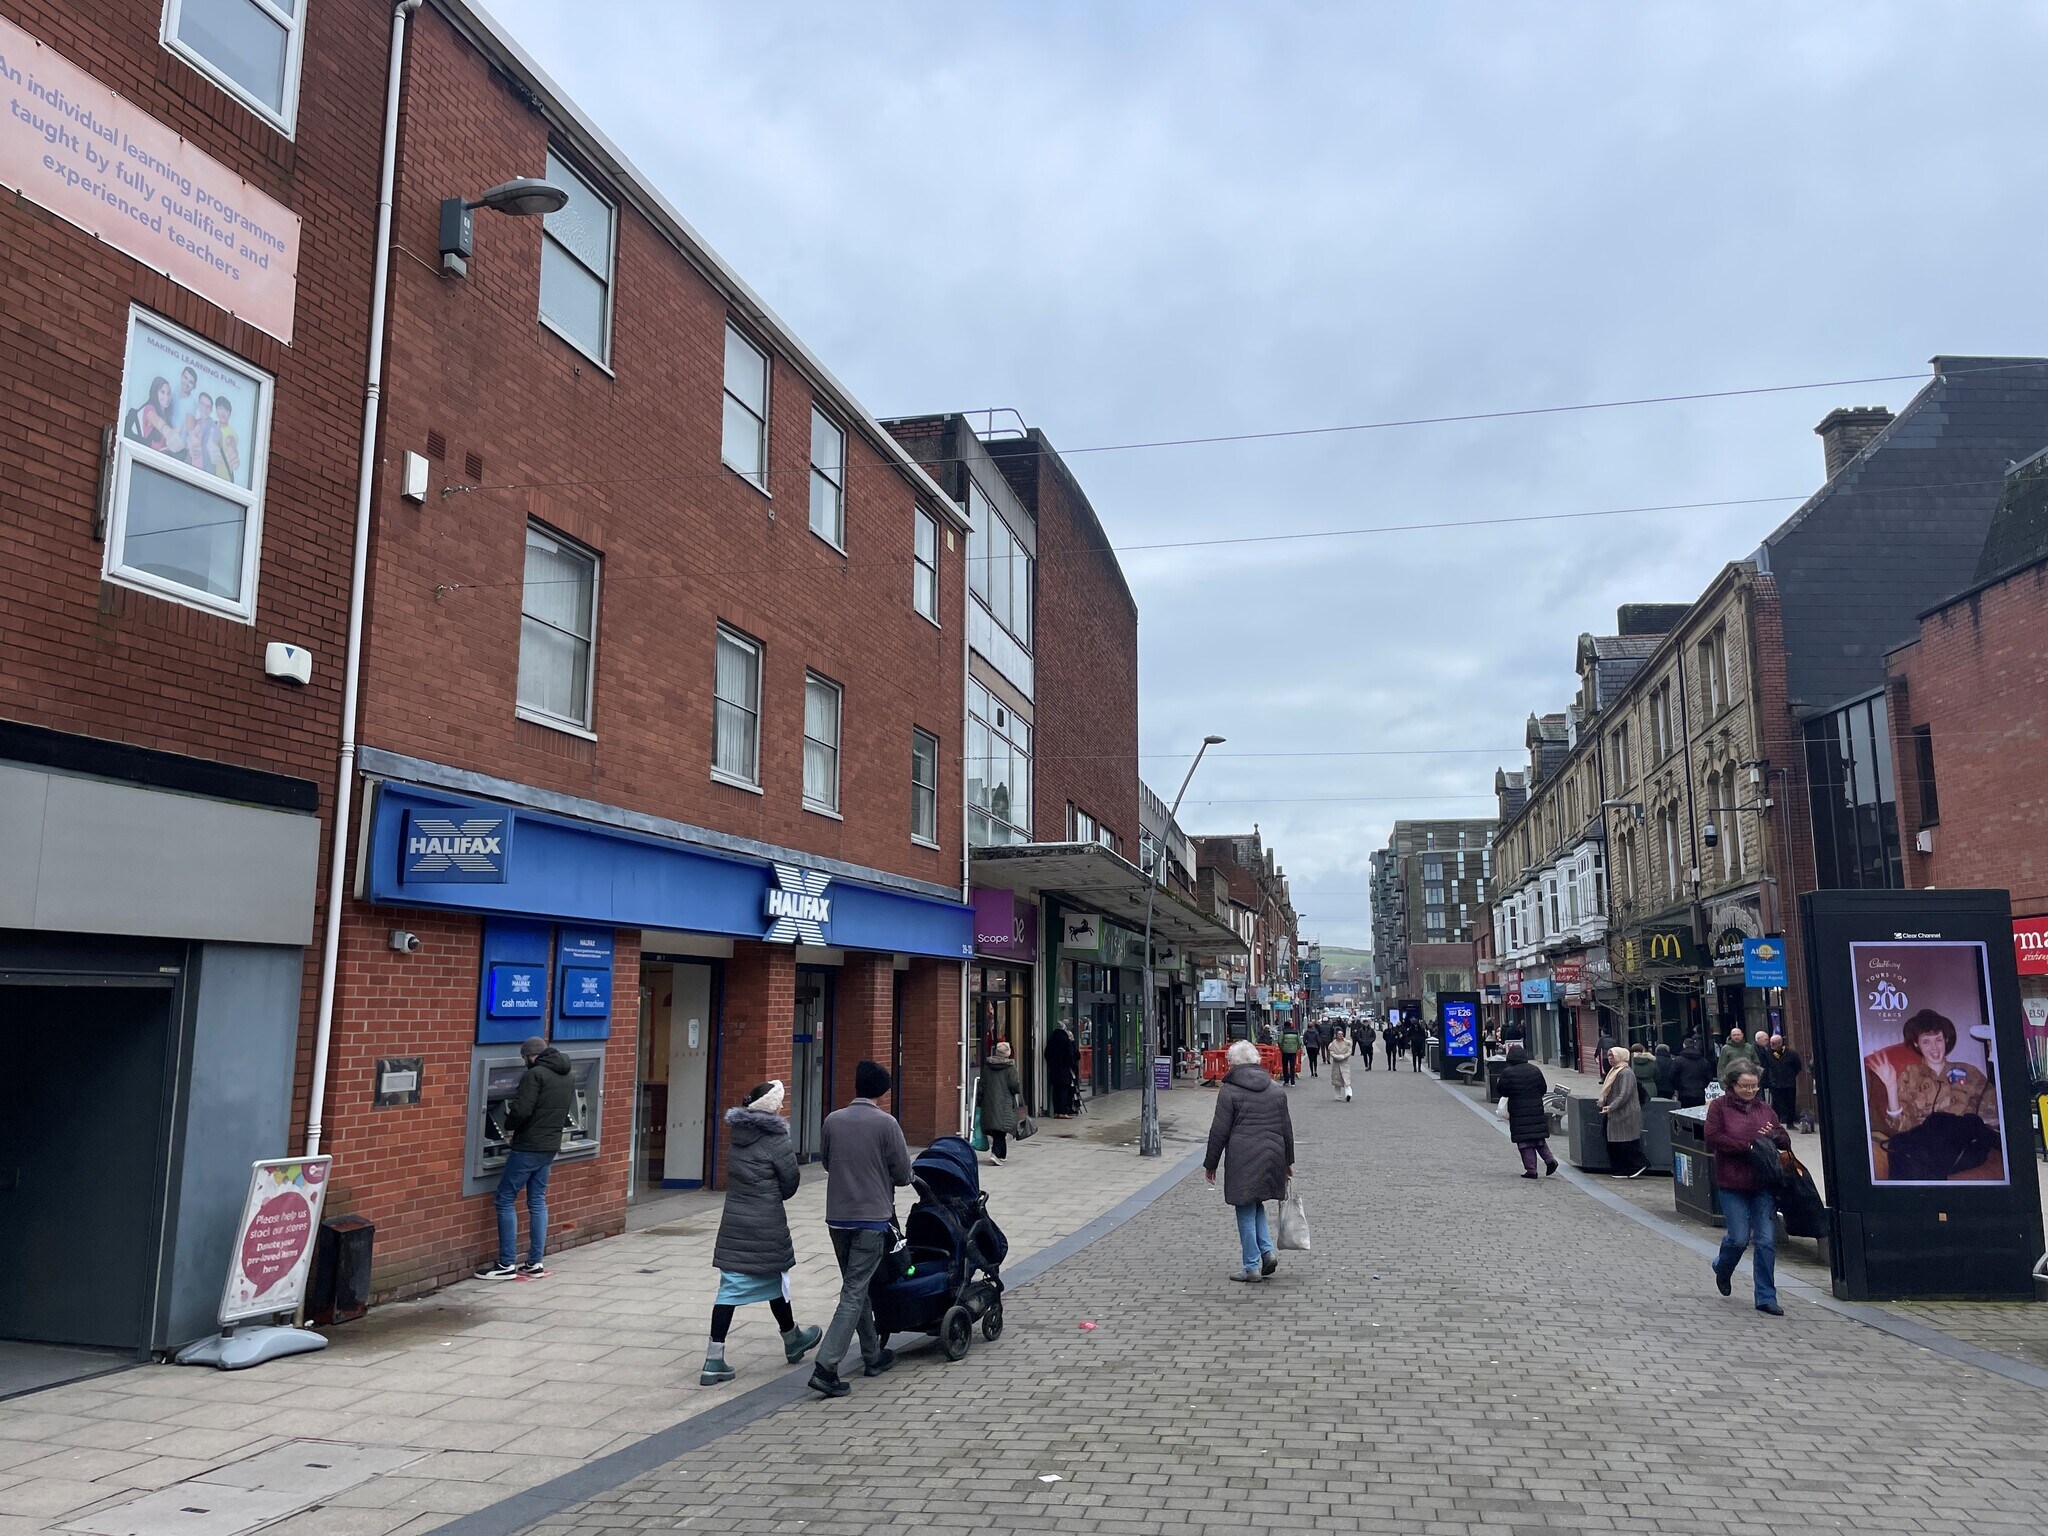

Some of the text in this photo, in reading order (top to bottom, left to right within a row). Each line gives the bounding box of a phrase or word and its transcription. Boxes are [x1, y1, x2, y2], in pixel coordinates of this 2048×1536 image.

[0, 55, 285, 252] An individual learning programme
[11, 98, 269, 270] taught by fully qualified and
[43, 154, 240, 280] experienced teachers
[147, 337, 180, 359] MAKING
[181, 354, 219, 379] LEARNING
[410, 837, 502, 854] HALIFAX
[769, 890, 830, 922] HALIFAX
[978, 933, 1009, 944] Scope
[1869, 957, 1901, 970] Cadbury
[511, 980, 531, 988] HALIFAX
[1866, 972, 1907, 984] YOURS FOR
[501, 998, 538, 1008] cash machine
[573, 1000, 605, 1008] cash machine
[1868, 991, 1909, 1010] 200
[256, 1209, 307, 1225] Please help us
[250, 1222, 308, 1239] stock our stores
[256, 1238, 296, 1252] Donate your
[280, 1248, 298, 1258] items
[262, 1264, 279, 1274] here
